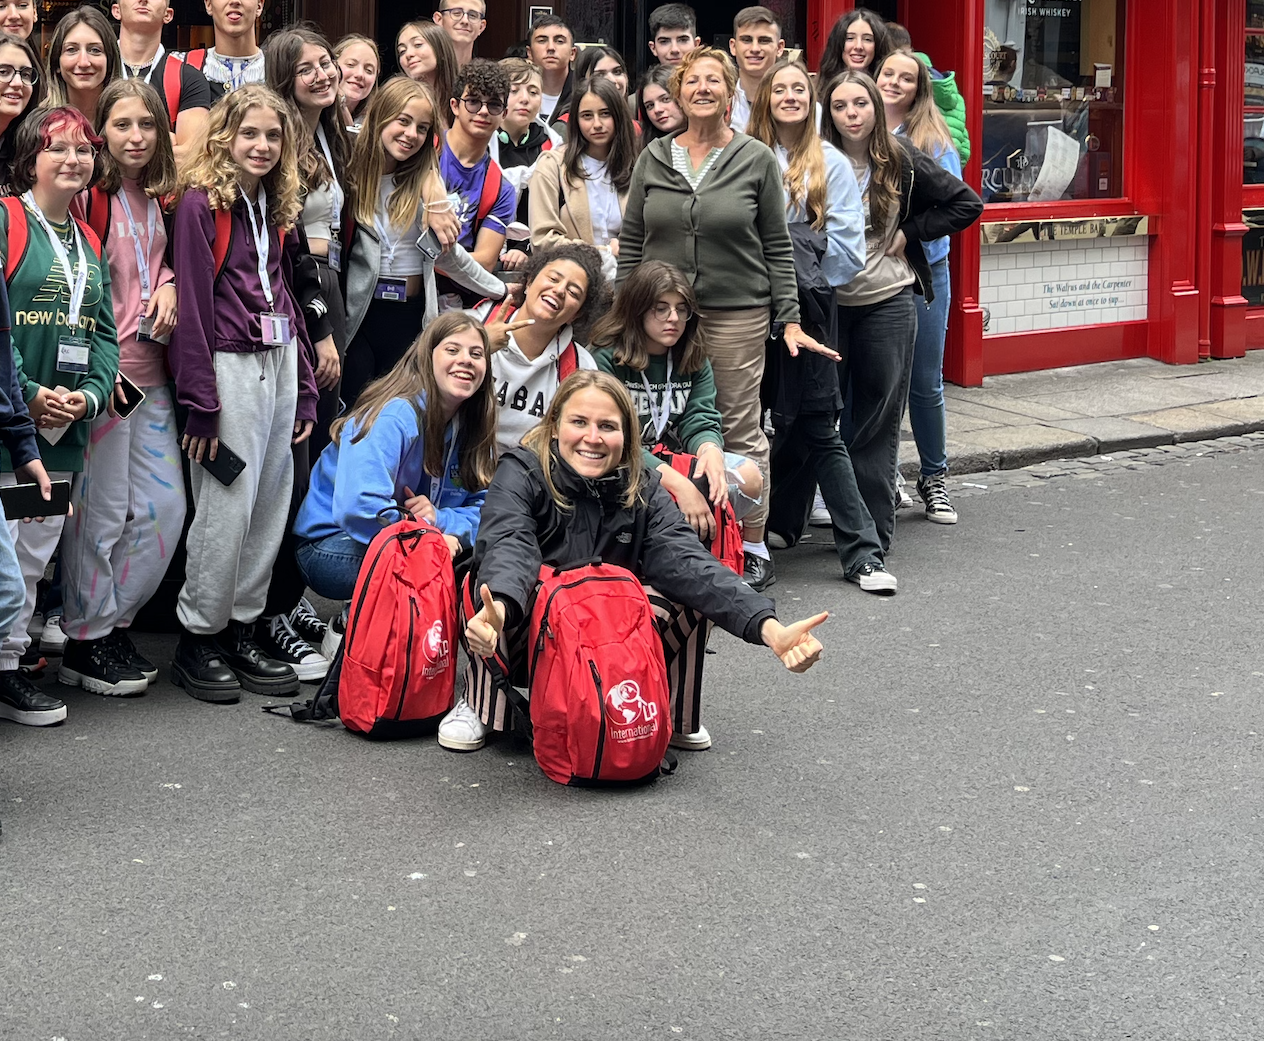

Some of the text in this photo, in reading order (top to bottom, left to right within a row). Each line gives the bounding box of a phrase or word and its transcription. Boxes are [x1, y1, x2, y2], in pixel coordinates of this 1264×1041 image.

[1018, 7, 1071, 17] IRISH WHISKEY
[1059, 223, 1087, 235] TEMPLE
[1043, 279, 1132, 294] The Walrus and the Carpenter
[1049, 299, 1059, 309] Sat
[1060, 298, 1077, 308] down
[1078, 298, 1084, 307] at
[1086, 298, 1099, 306] once
[1100, 296, 1107, 305] to
[16, 310, 53, 326] new
[643, 702, 658, 722] LP
[611, 718, 658, 740] International
